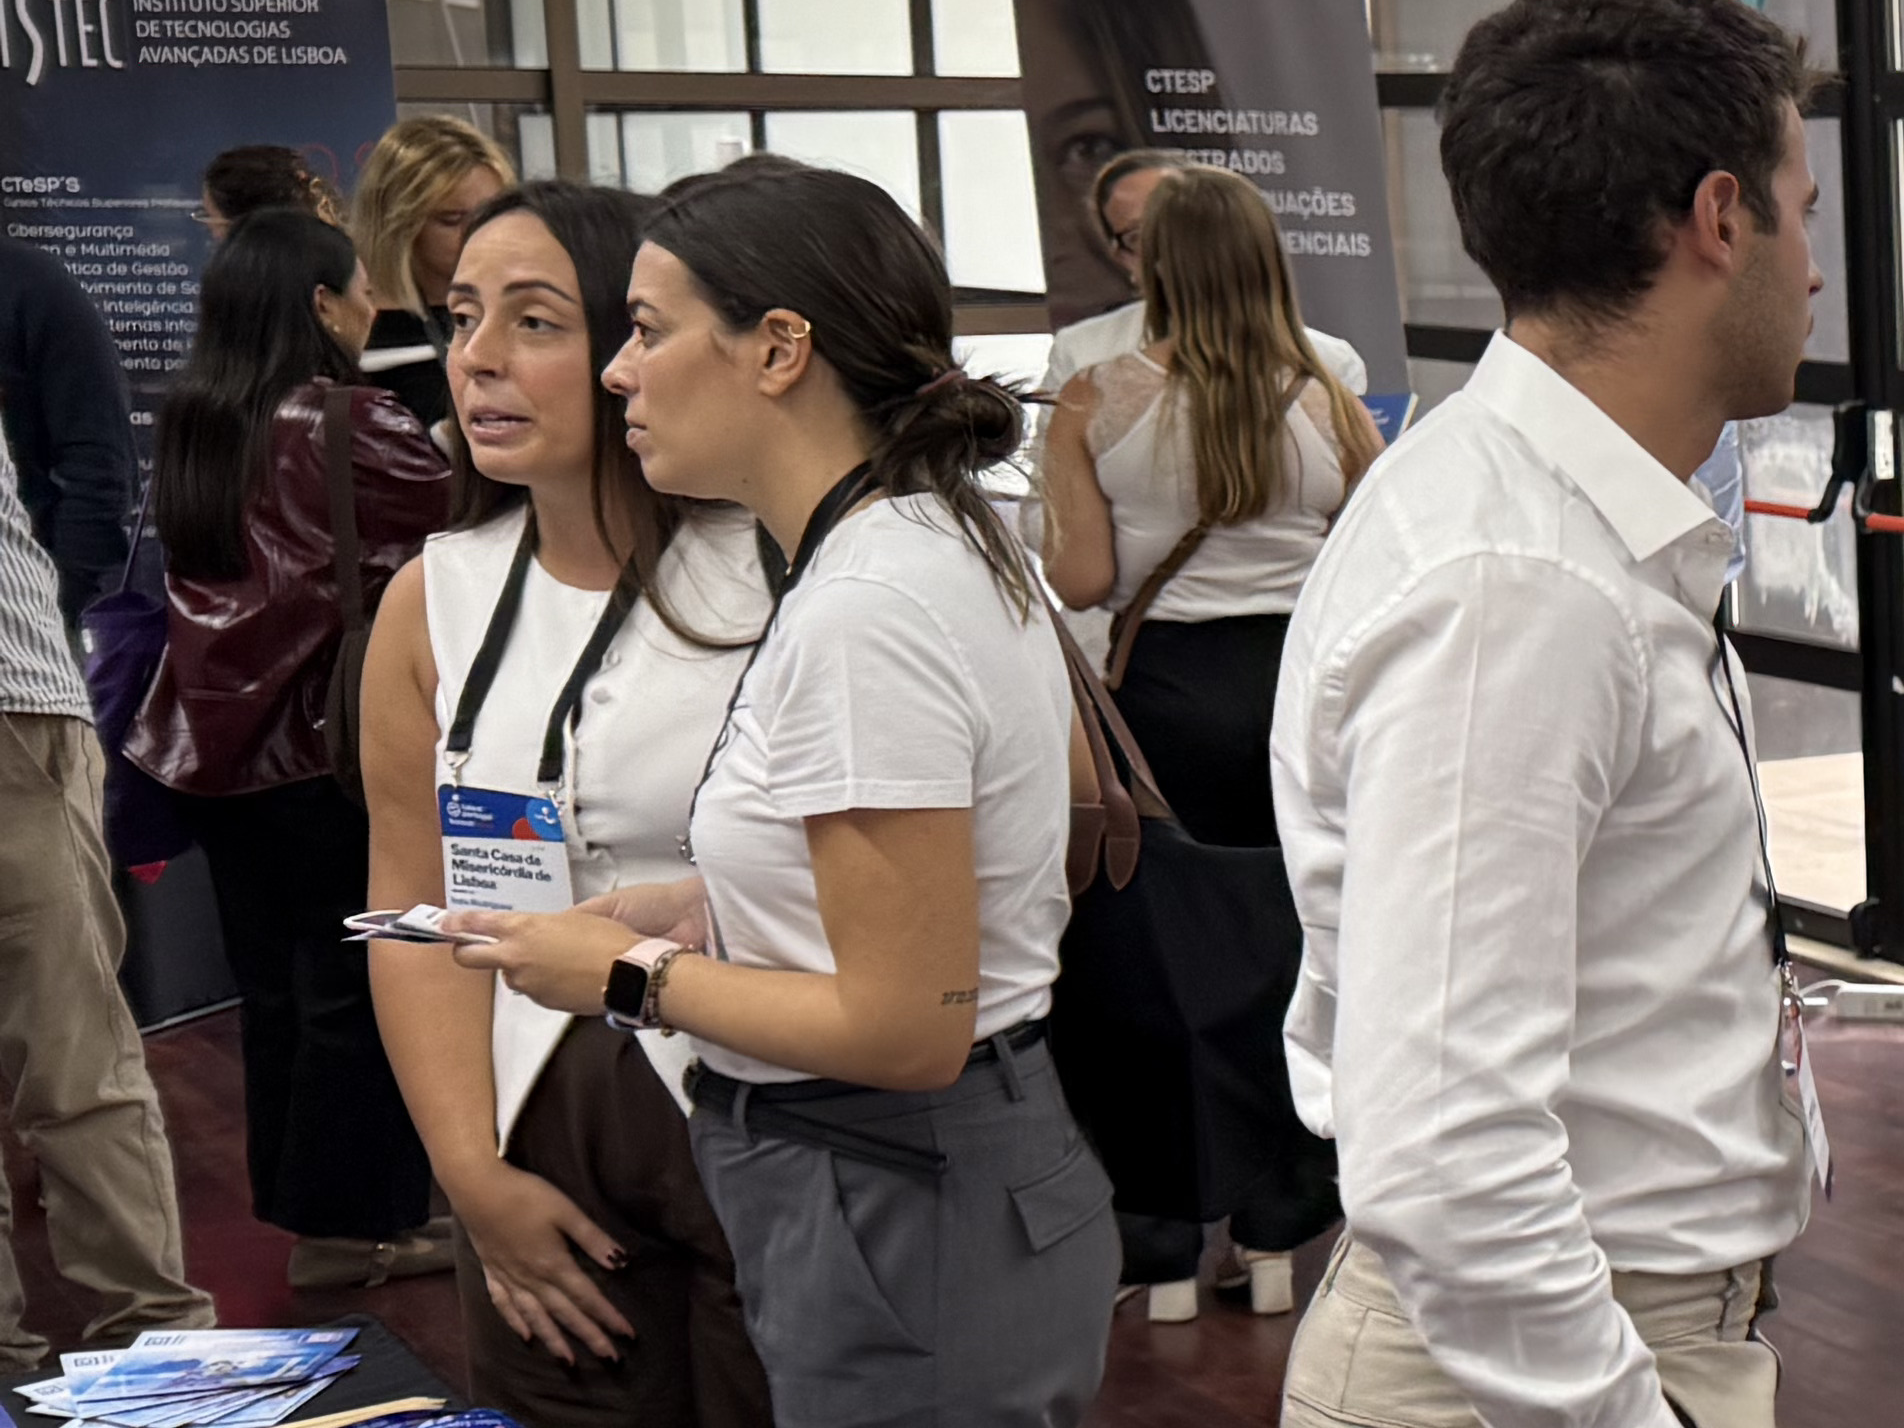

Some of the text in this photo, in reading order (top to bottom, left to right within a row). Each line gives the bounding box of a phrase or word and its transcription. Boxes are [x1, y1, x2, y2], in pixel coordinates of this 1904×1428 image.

[136, 21, 290, 39] DE TECNOLOGIAS
[139, 46, 347, 68] AVANÇADAS DE LISBOA
[1145, 69, 1215, 93] CTESP
[1151, 109, 1319, 136] LICENCIATURAS
[7, 223, 134, 240] Cibersegurança
